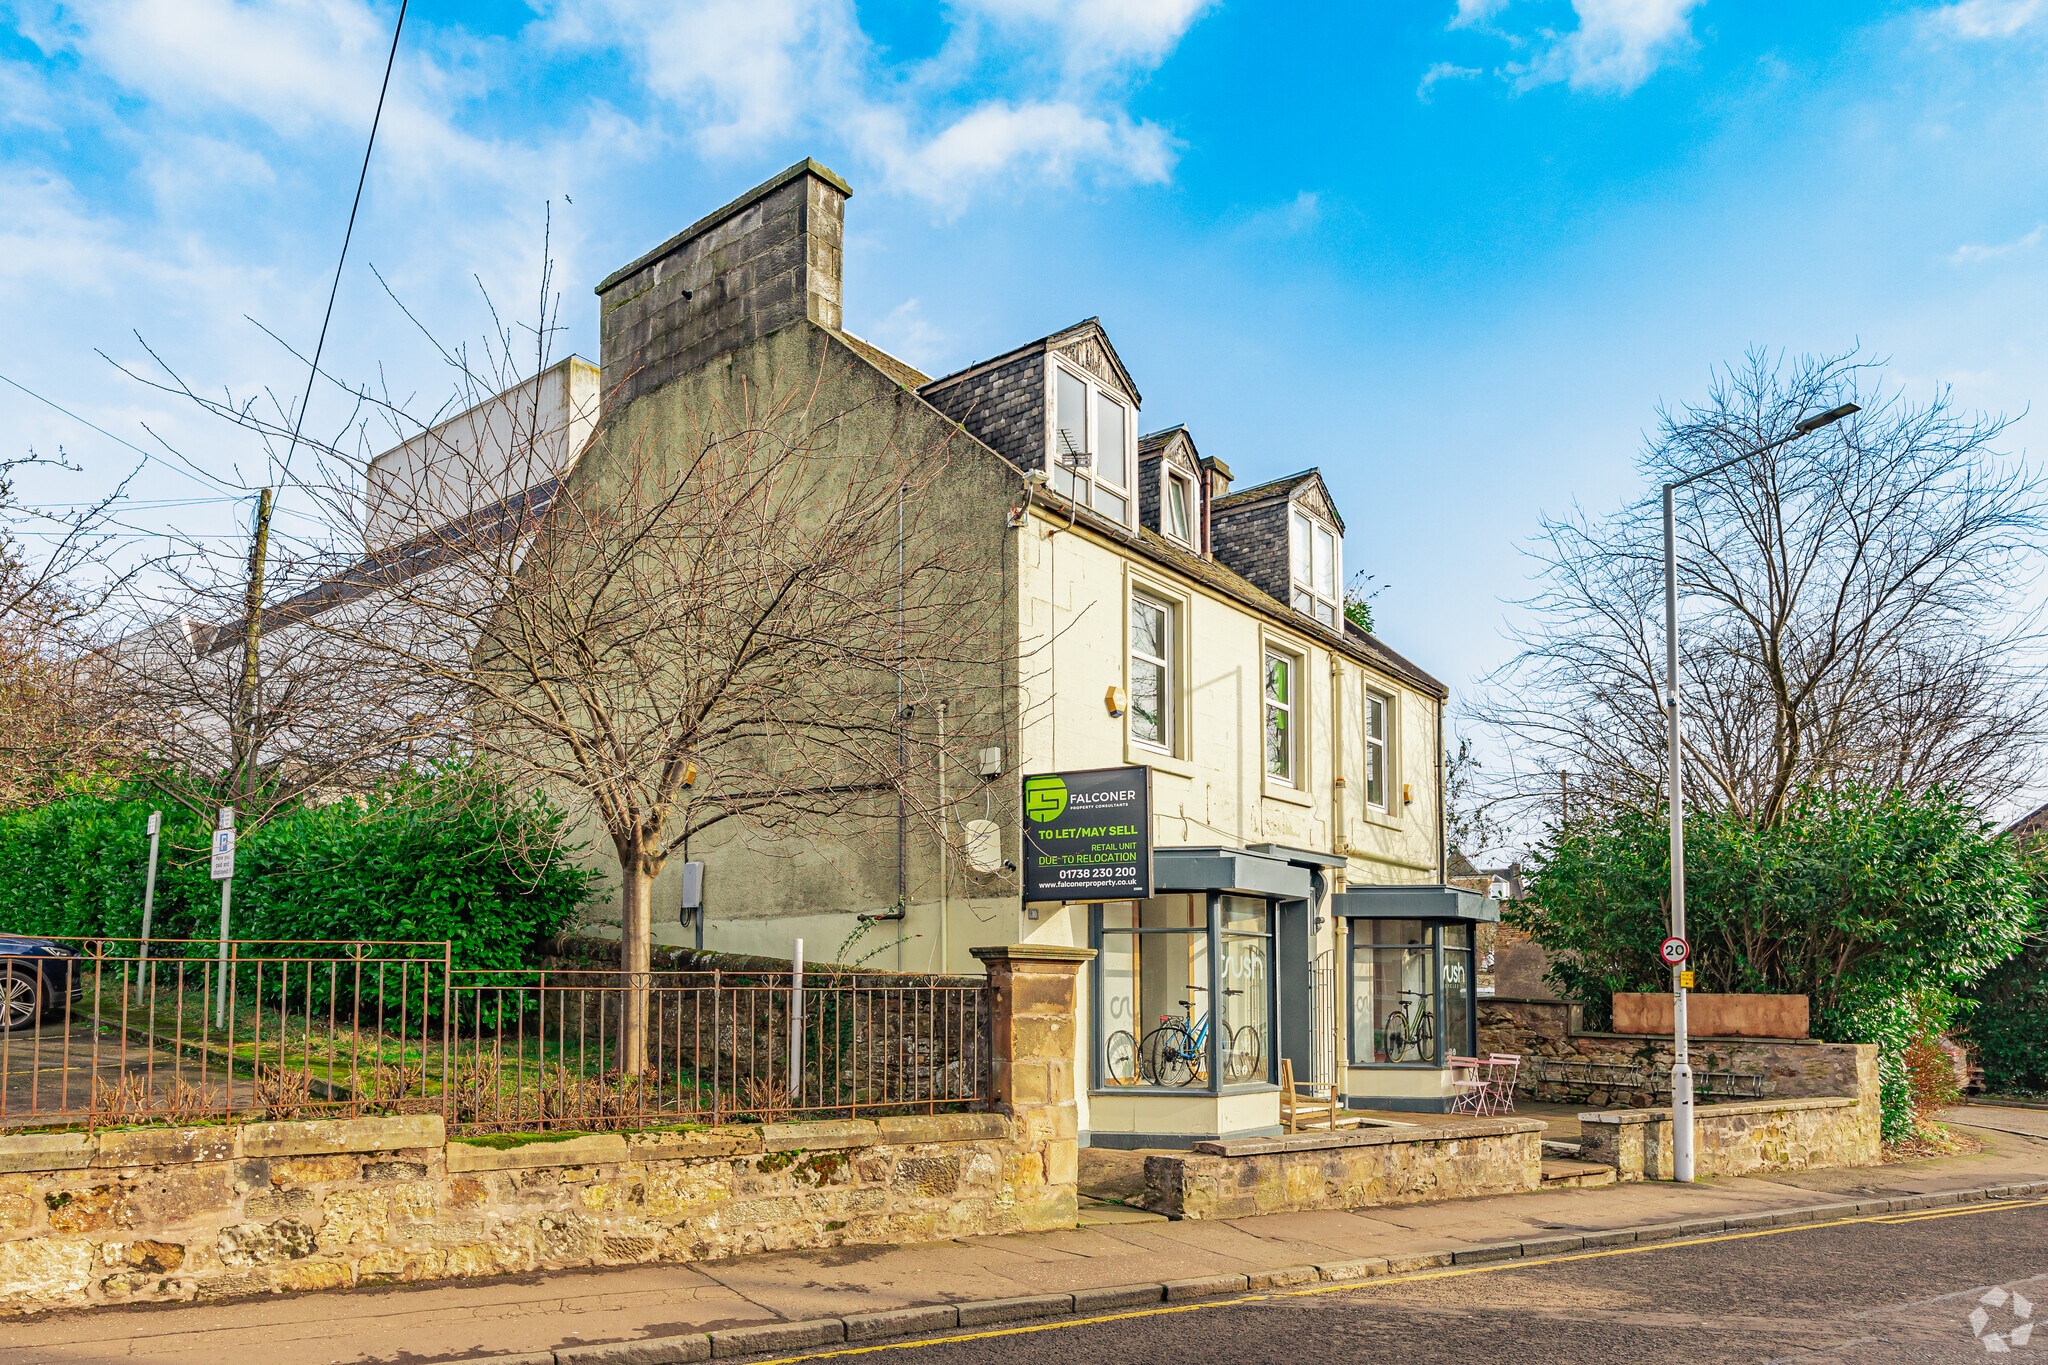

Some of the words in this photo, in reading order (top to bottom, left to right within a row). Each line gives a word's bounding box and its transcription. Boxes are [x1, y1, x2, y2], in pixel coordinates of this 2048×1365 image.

[1070, 790, 1136, 804] FALCONER
[1038, 830, 1053, 840] TO
[1056, 826, 1107, 839] LET/MAY
[1109, 825, 1138, 836] SELL
[1092, 844, 1117, 852] RETAIL
[1119, 842, 1137, 850] UNIT
[1038, 856, 1058, 866] DUE
[1062, 855, 1074, 864] TO
[1076, 852, 1136, 864] RELOCATION
[1060, 869, 1090, 879] 01738
[1092, 868, 1112, 878] 230
[1115, 867, 1136, 876] 200
[1038, 879, 1136, 888] www.falconerproperty.co.uk
[1666, 945, 1684, 956] 20
[1443, 962, 1464, 983] rush
